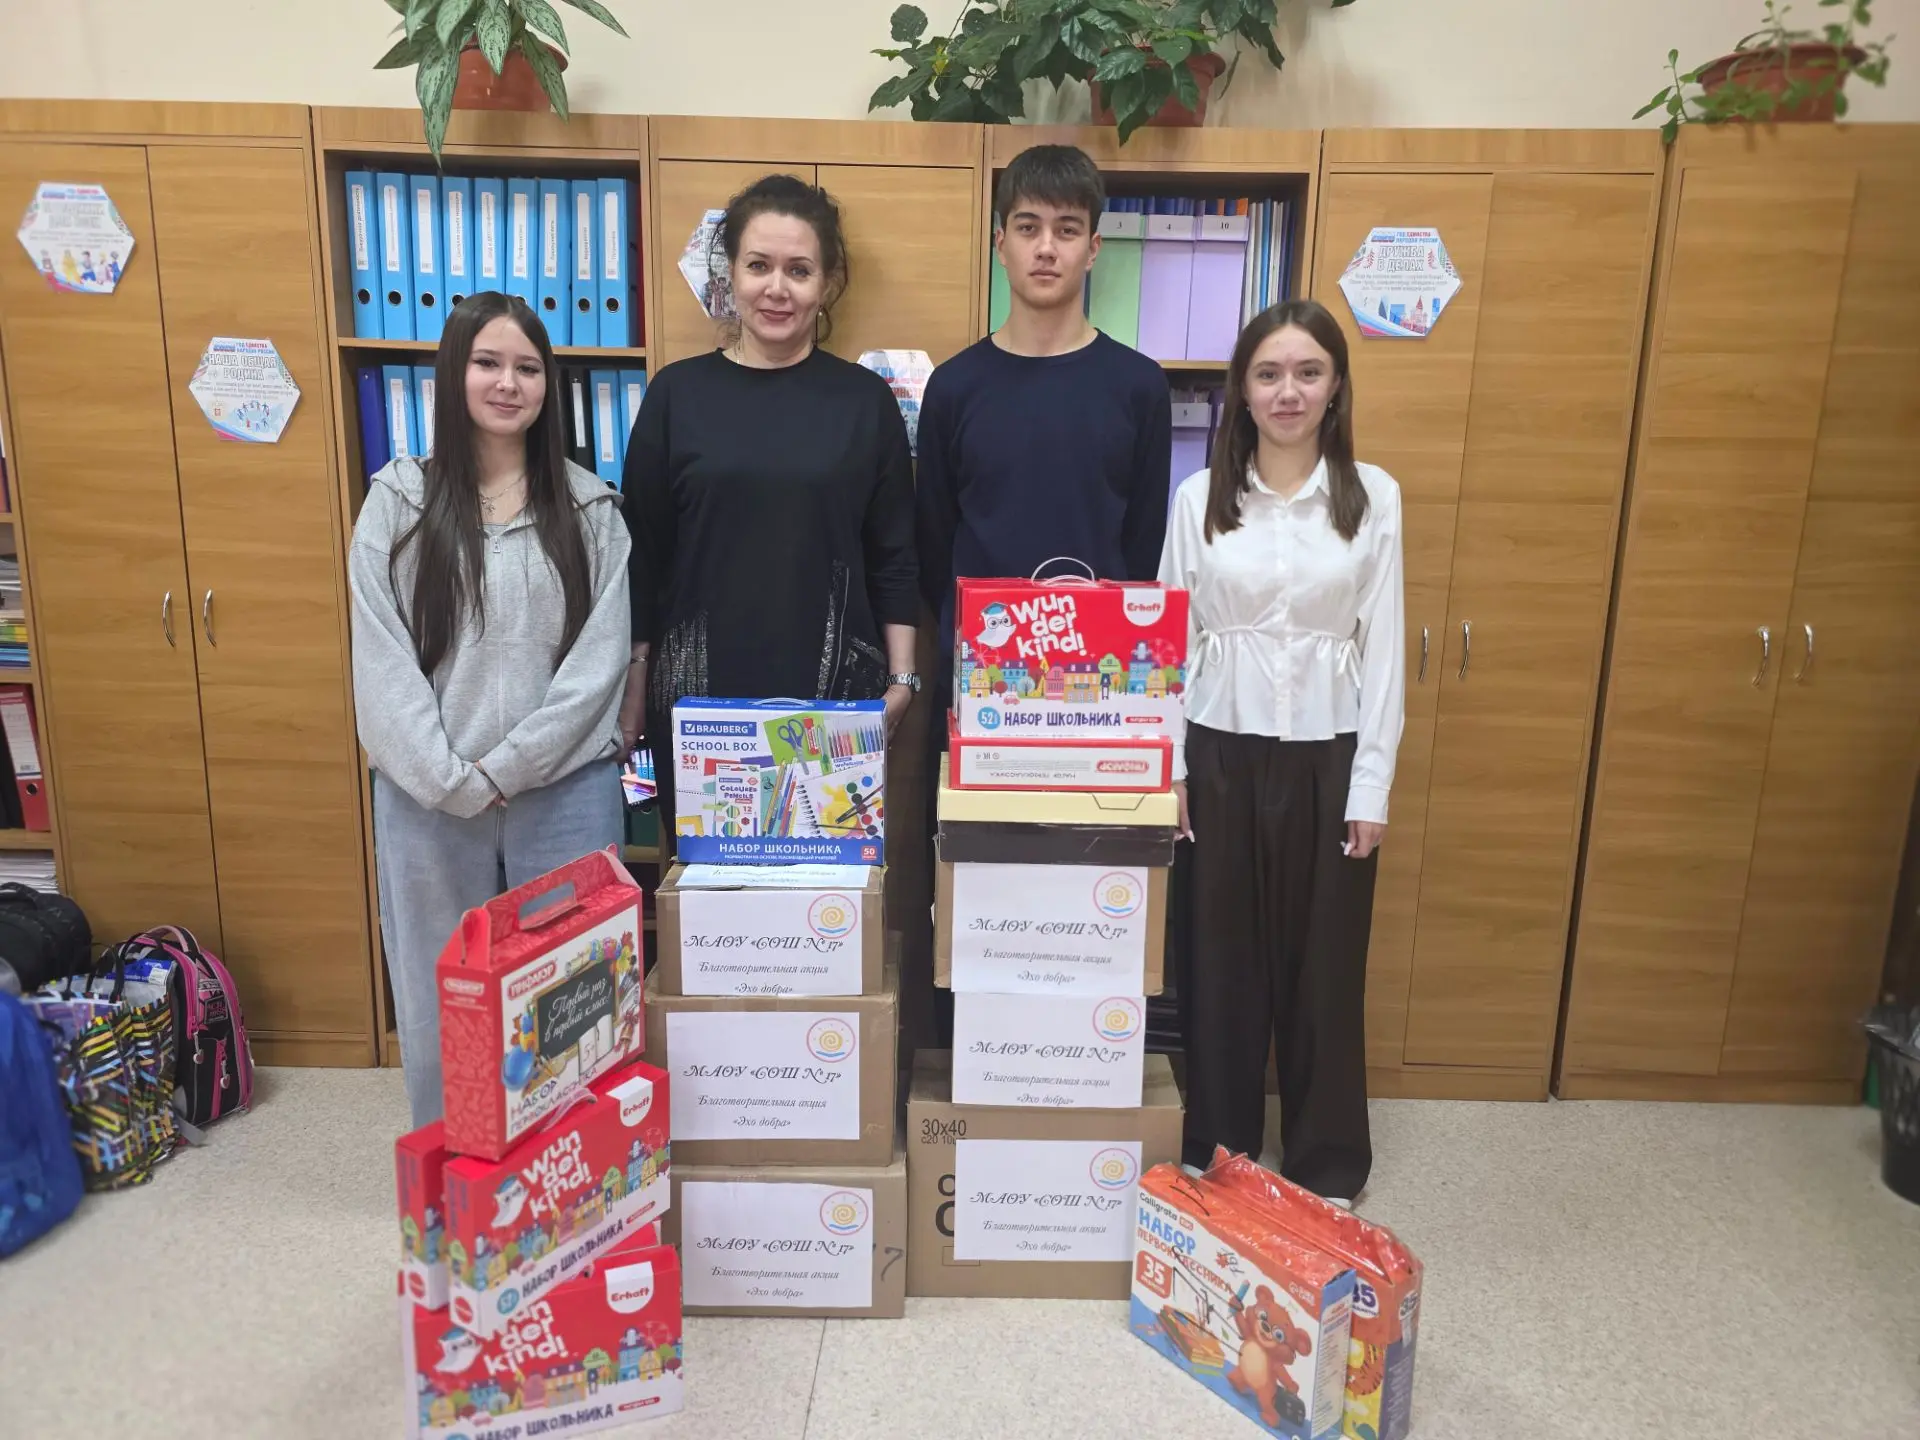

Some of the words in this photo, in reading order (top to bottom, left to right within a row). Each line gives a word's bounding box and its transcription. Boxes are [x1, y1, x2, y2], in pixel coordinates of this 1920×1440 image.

[1166, 223, 1172, 231] 4
[1220, 222, 1229, 230] 10
[1379, 246, 1425, 258] ДРУЖБА
[1377, 259, 1385, 271] В
[1387, 259, 1425, 272] ДЕЛАХ
[209, 354, 239, 367] НАША
[240, 356, 276, 369] ОБЩАЯ
[223, 367, 265, 381] РОДИНА
[1010, 593, 1075, 625] Wun
[1031, 611, 1077, 637] der
[1016, 628, 1087, 661] kind!
[981, 712, 994, 724] 52
[1004, 712, 1043, 726] НАБОР
[1046, 712, 1121, 726] ШКОЛЬНИКА
[696, 724, 748, 734] BRAUBERG
[681, 741, 730, 751] SCHOOL
[733, 742, 757, 752] BOX
[682, 754, 698, 764] 50
[719, 843, 761, 854] НАБОР
[764, 844, 842, 855] ШКОЛЬНИКА
[863, 847, 875, 855] 50
[969, 918, 1033, 932] МАОУ
[1035, 921, 1086, 936] «СОШ
[683, 935, 748, 949] МАОУ
[750, 936, 801, 951] «СОШ
[983, 948, 1081, 964] Благотворительная
[1083, 954, 1112, 965] акция
[699, 961, 797, 976] Благотворительная
[800, 965, 829, 976] акция
[969, 1041, 1033, 1055] МАОУ
[1035, 1044, 1084, 1059] «СОШ
[683, 1065, 747, 1079] МАОУ
[750, 1066, 800, 1080] «СОШ
[982, 1071, 1080, 1087] Благотворительная
[1082, 1077, 1110, 1088] акция
[511, 1080, 557, 1119] НАБОР
[698, 1094, 796, 1109] Благотворительная
[798, 1099, 827, 1112] акция
[521, 1130, 582, 1185] Wun
[542, 1148, 582, 1190] der
[529, 1162, 593, 1220] kind!
[970, 1191, 1032, 1206] МАОУ
[1034, 1194, 1082, 1208] «СОШ
[1140, 1191, 1178, 1221] Calligrata
[983, 1220, 1077, 1235] Благотворительная
[1079, 1224, 1107, 1235] акция
[1138, 1207, 1196, 1256] НАБОР
[696, 1237, 760, 1251] МАОУ
[763, 1238, 812, 1252] «СОШ
[522, 1264, 558, 1298] НАБОР
[560, 1218, 624, 1273] ШКОЛЬНИКА
[711, 1265, 809, 1280] Благотворительная
[810, 1270, 839, 1282] акция
[1143, 1255, 1166, 1286] 35
[500, 1318, 554, 1351] der
[483, 1333, 569, 1376] kind!
[476, 1425, 521, 1440] НАБОР
[526, 1403, 614, 1437] ШКОЛЬНИКА
